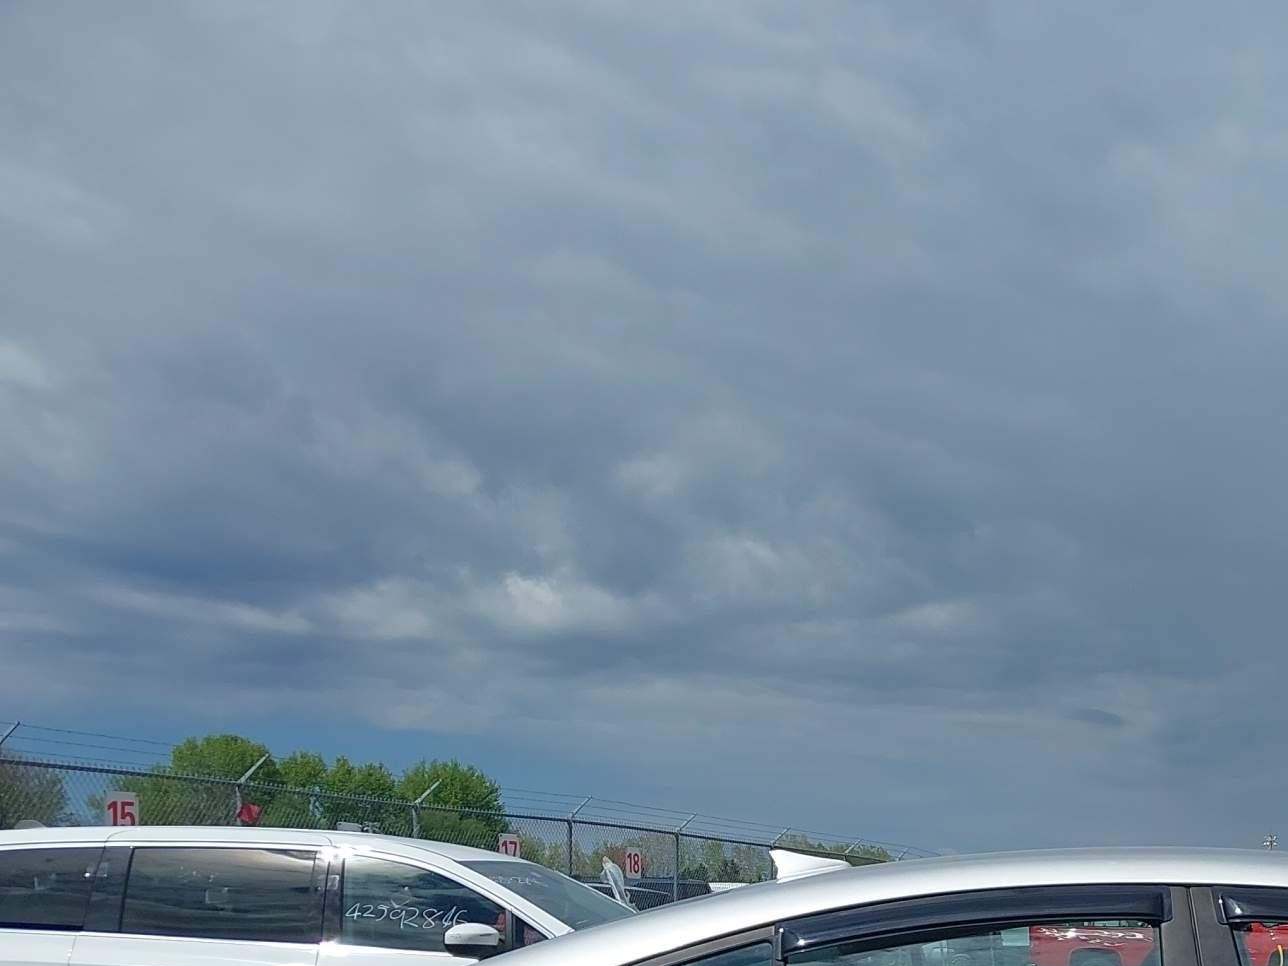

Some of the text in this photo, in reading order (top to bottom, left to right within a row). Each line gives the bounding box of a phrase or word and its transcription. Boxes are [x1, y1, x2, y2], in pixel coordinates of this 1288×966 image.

[107, 801, 135, 826] 15
[501, 840, 517, 857] 17
[627, 852, 640, 874] 18
